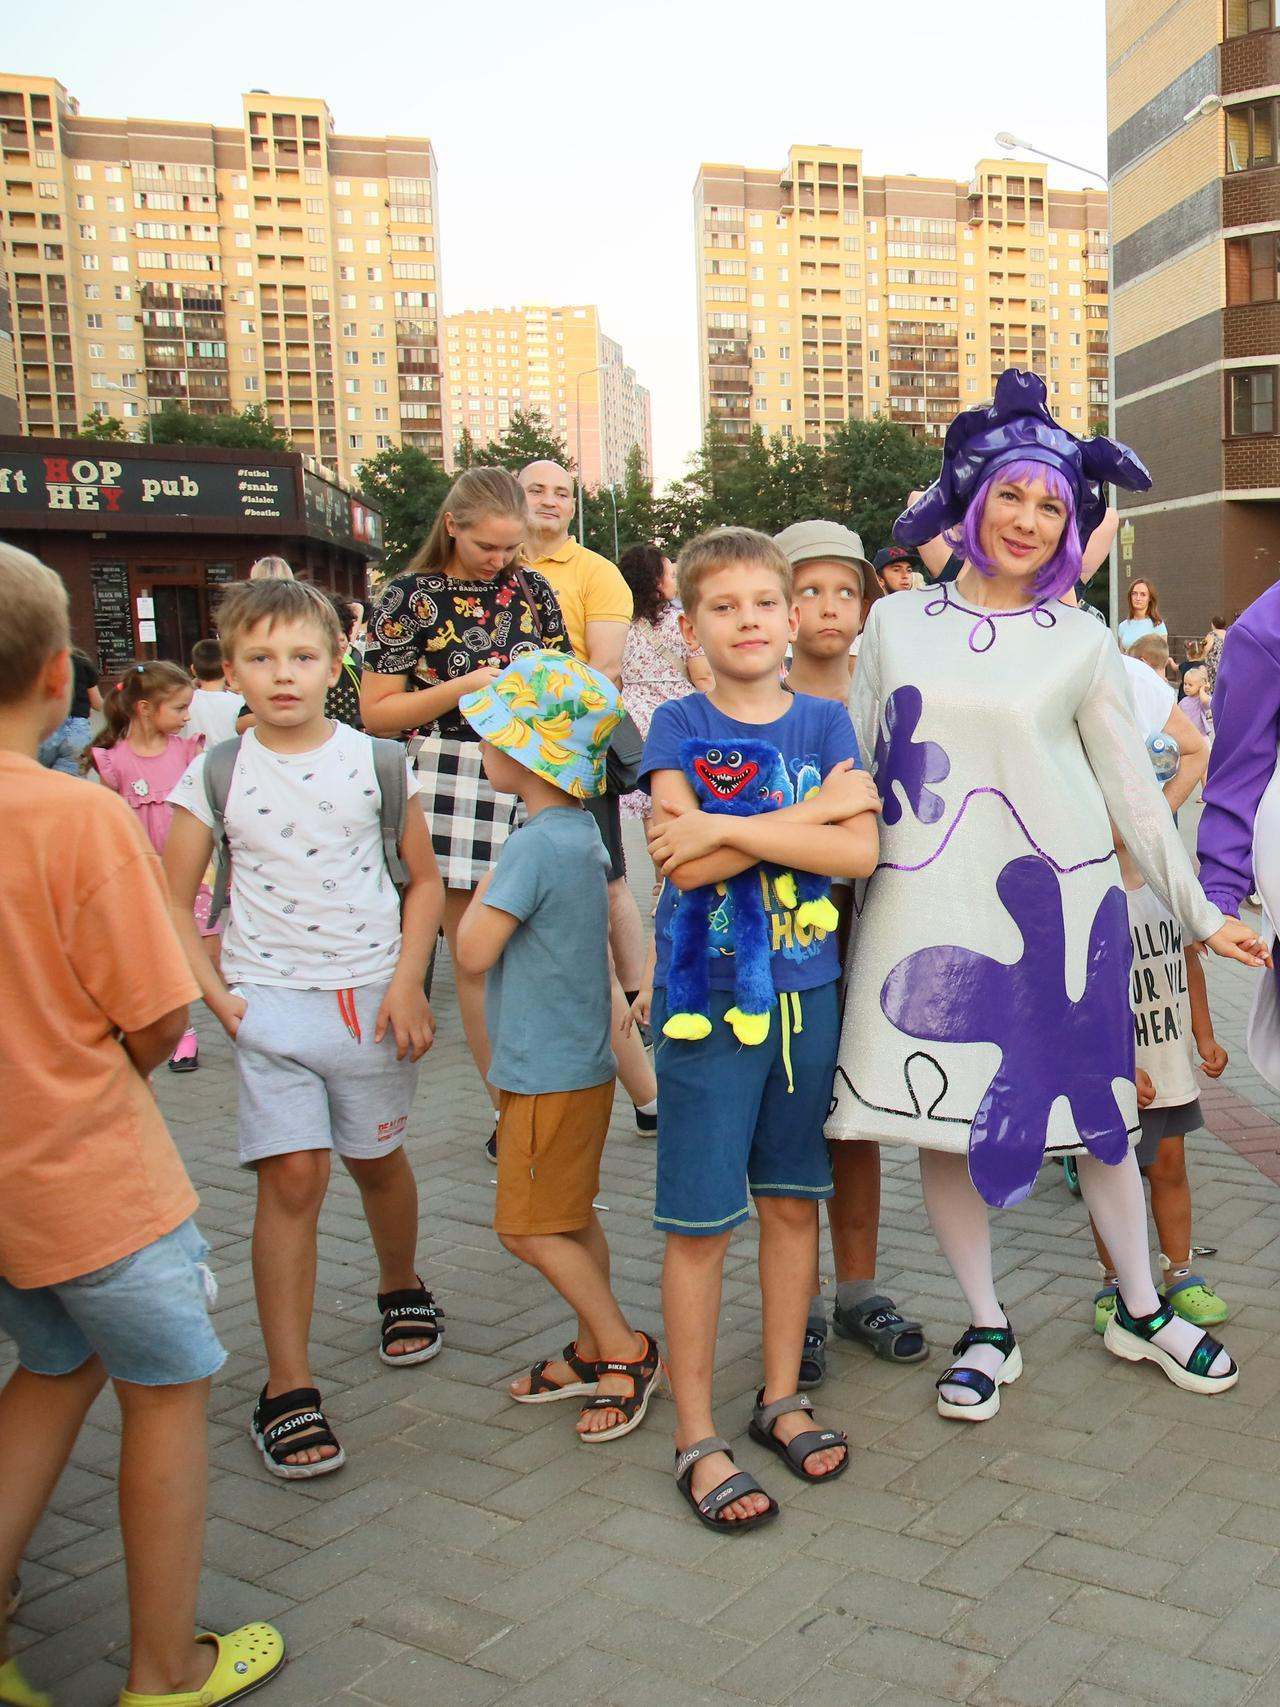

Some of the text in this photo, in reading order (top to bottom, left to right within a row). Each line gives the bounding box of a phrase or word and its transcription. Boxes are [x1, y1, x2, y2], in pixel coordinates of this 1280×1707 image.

[43, 456, 123, 485] HOP
[237, 469, 270, 478] #futbol
[46, 485, 124, 512] HEY
[141, 475, 200, 503] pub
[238, 481, 279, 492] #snaks
[399, 1306, 436, 1318] SPORTS
[270, 1411, 324, 1440] FASHION
